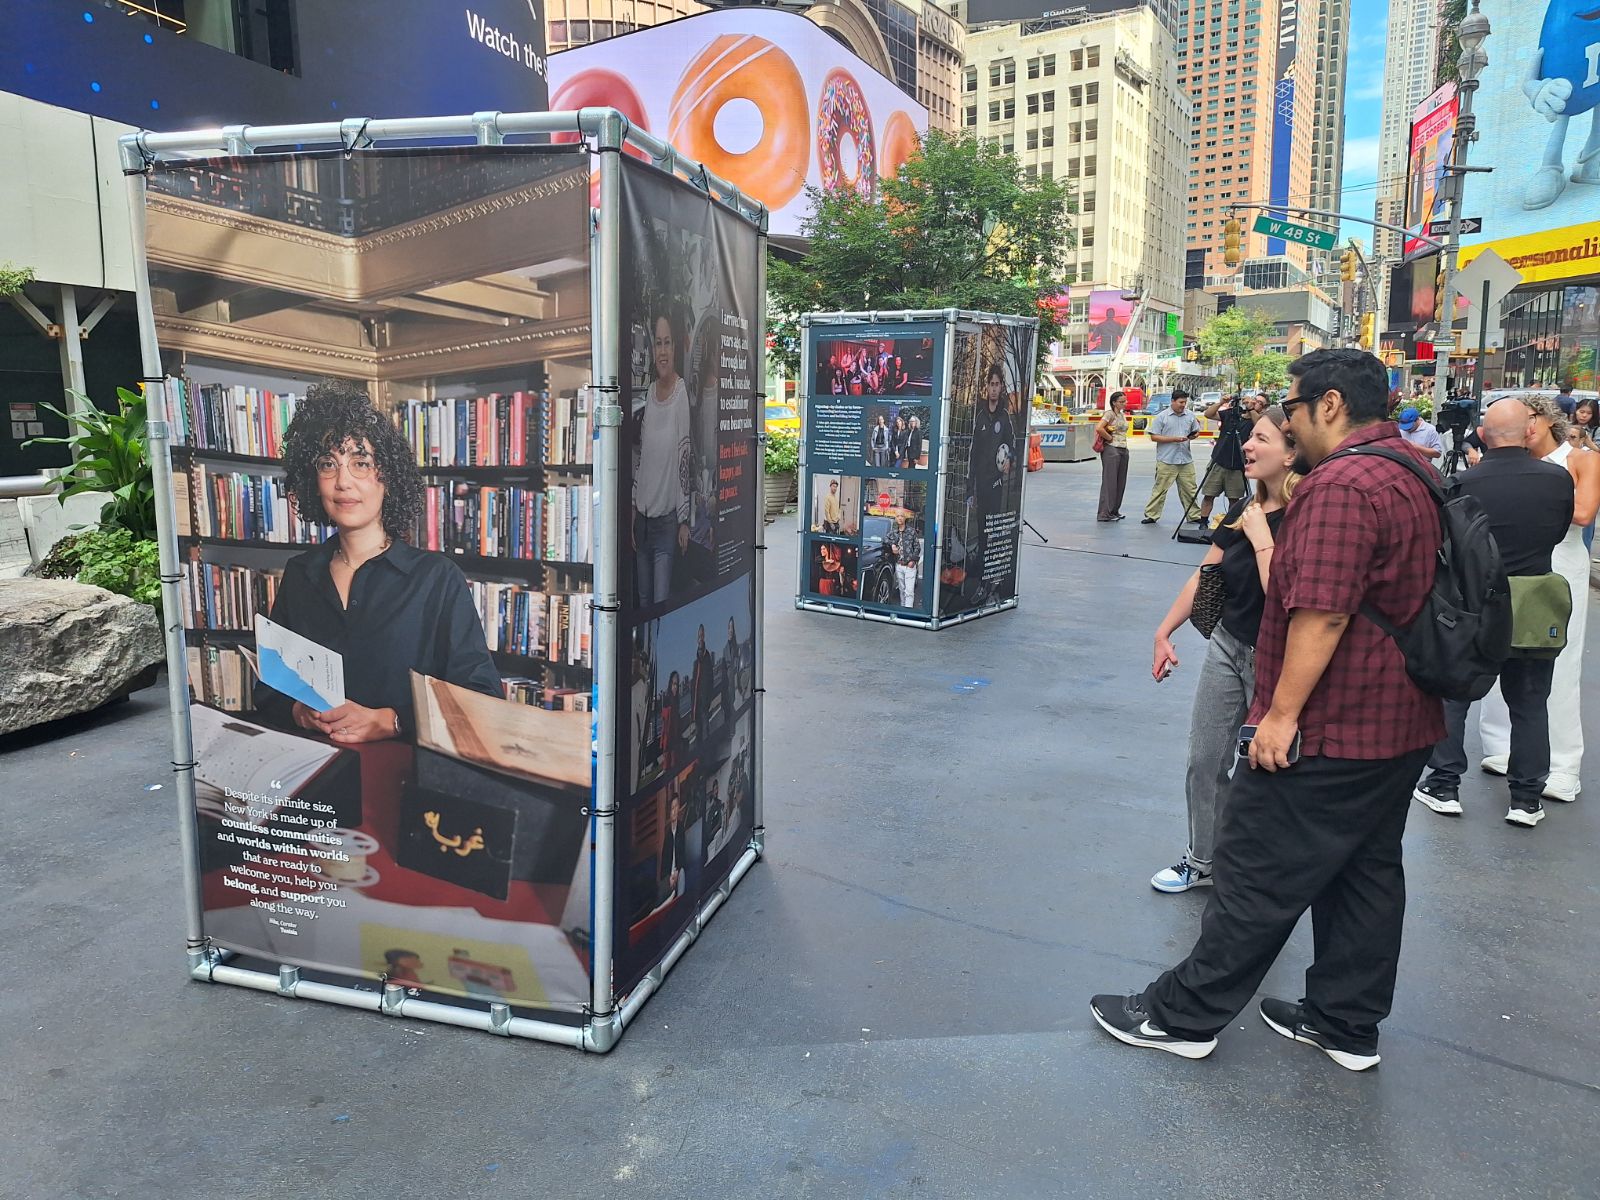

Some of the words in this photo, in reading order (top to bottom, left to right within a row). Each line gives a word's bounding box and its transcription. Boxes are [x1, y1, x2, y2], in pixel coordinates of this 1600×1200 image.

[466, 9, 520, 62] Watch
[524, 43, 543, 76] the
[1269, 222, 1281, 234] W
[1284, 226, 1303, 240] 48
[1305, 231, 1322, 244] St
[1504, 236, 1600, 270] ersonali
[720, 397, 725, 410] to
[224, 787, 260, 804] Despite
[261, 794, 273, 805] its
[275, 796, 310, 810] infinite
[312, 801, 336, 814] size,
[224, 802, 245, 814] New
[247, 806, 269, 819] York
[270, 810, 278, 822] is
[280, 814, 308, 826] made
[311, 818, 325, 829] up
[326, 818, 338, 829] of
[221, 817, 269, 835] countless
[271, 827, 342, 846] communities
[217, 831, 235, 843] and
[236, 835, 271, 850] worlds
[272, 842, 308, 857] within
[310, 849, 350, 862] worlds
[242, 850, 261, 863] that
[263, 856, 278, 867] are
[280, 858, 309, 873] ready
[310, 863, 322, 873] to
[230, 864, 270, 879] welcome
[272, 872, 293, 885] you,
[295, 874, 316, 889] help
[318, 880, 337, 891] you
[250, 898, 276, 913] along
[278, 902, 293, 914] the
[295, 908, 319, 919] way.
[260, 887, 278, 897] and
[280, 889, 325, 905] support
[326, 897, 347, 908] you
